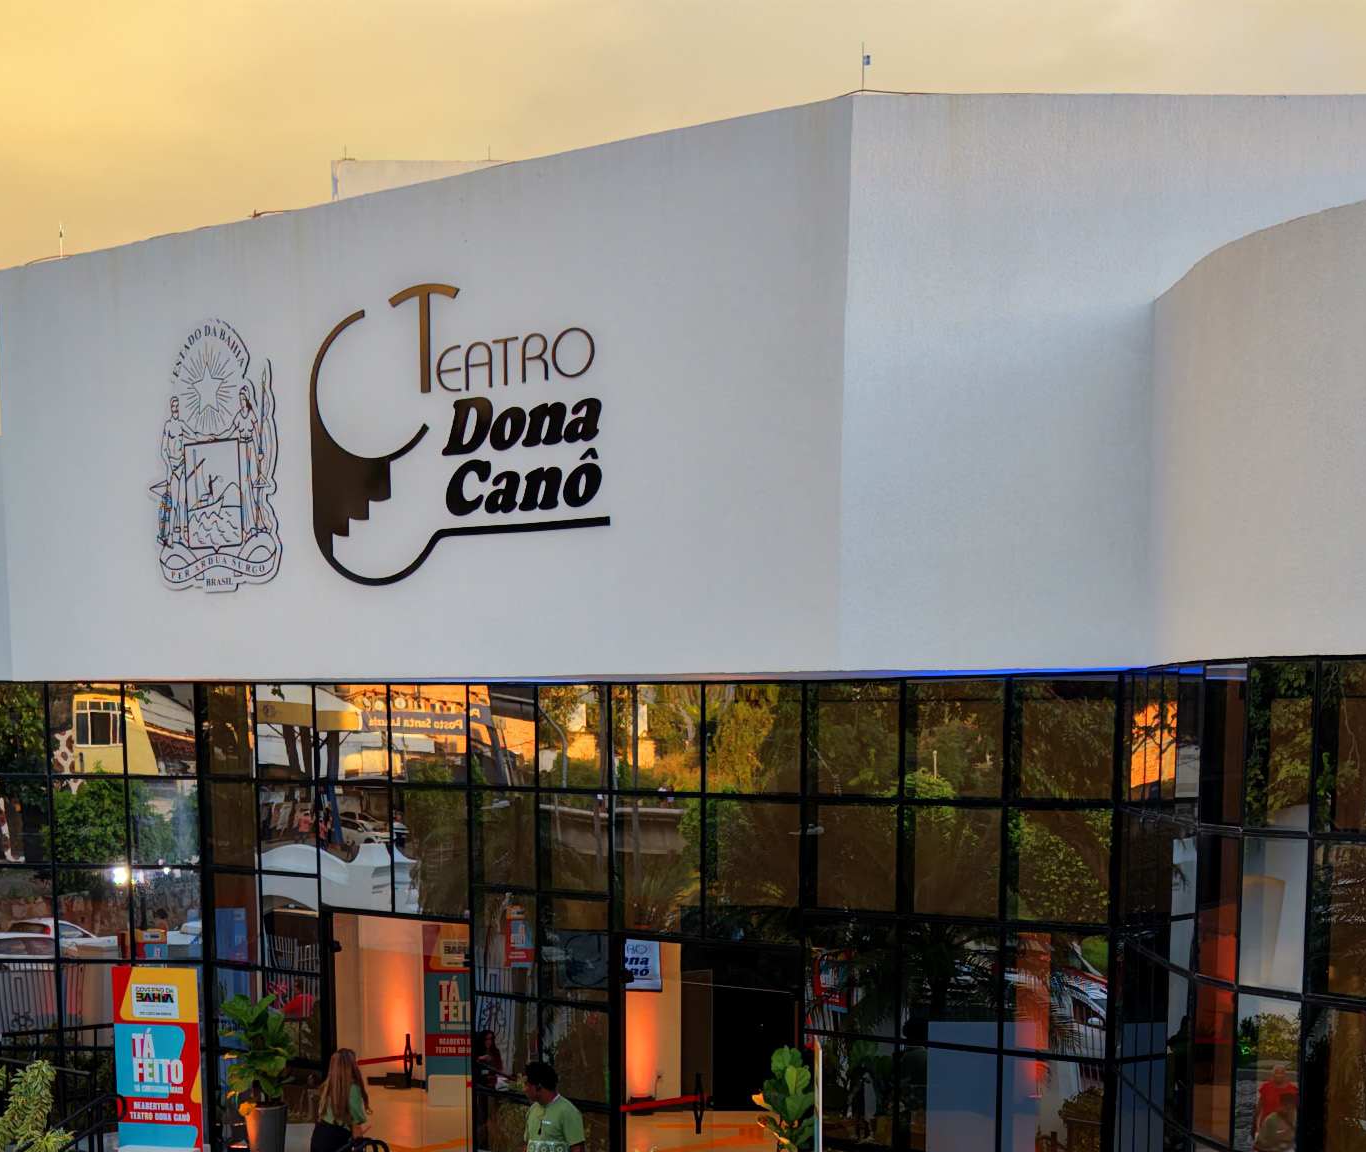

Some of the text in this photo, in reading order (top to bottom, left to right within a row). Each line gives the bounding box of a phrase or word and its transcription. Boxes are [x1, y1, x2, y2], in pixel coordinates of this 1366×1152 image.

[172, 324, 245, 378] ESTADO DA BAHIA
[388, 283, 595, 394] TEATRO
[441, 396, 603, 457] Dona
[444, 447, 604, 517] Canô
[206, 578, 234, 587] BRASIL
[136, 992, 174, 1003] BAHIA
[439, 975, 460, 1001] TÁ
[439, 1001, 471, 1022] FEIT
[131, 1027, 155, 1059] TÁ
[132, 1058, 184, 1085] FEITO
[129, 1111, 154, 1121] TEATRO
